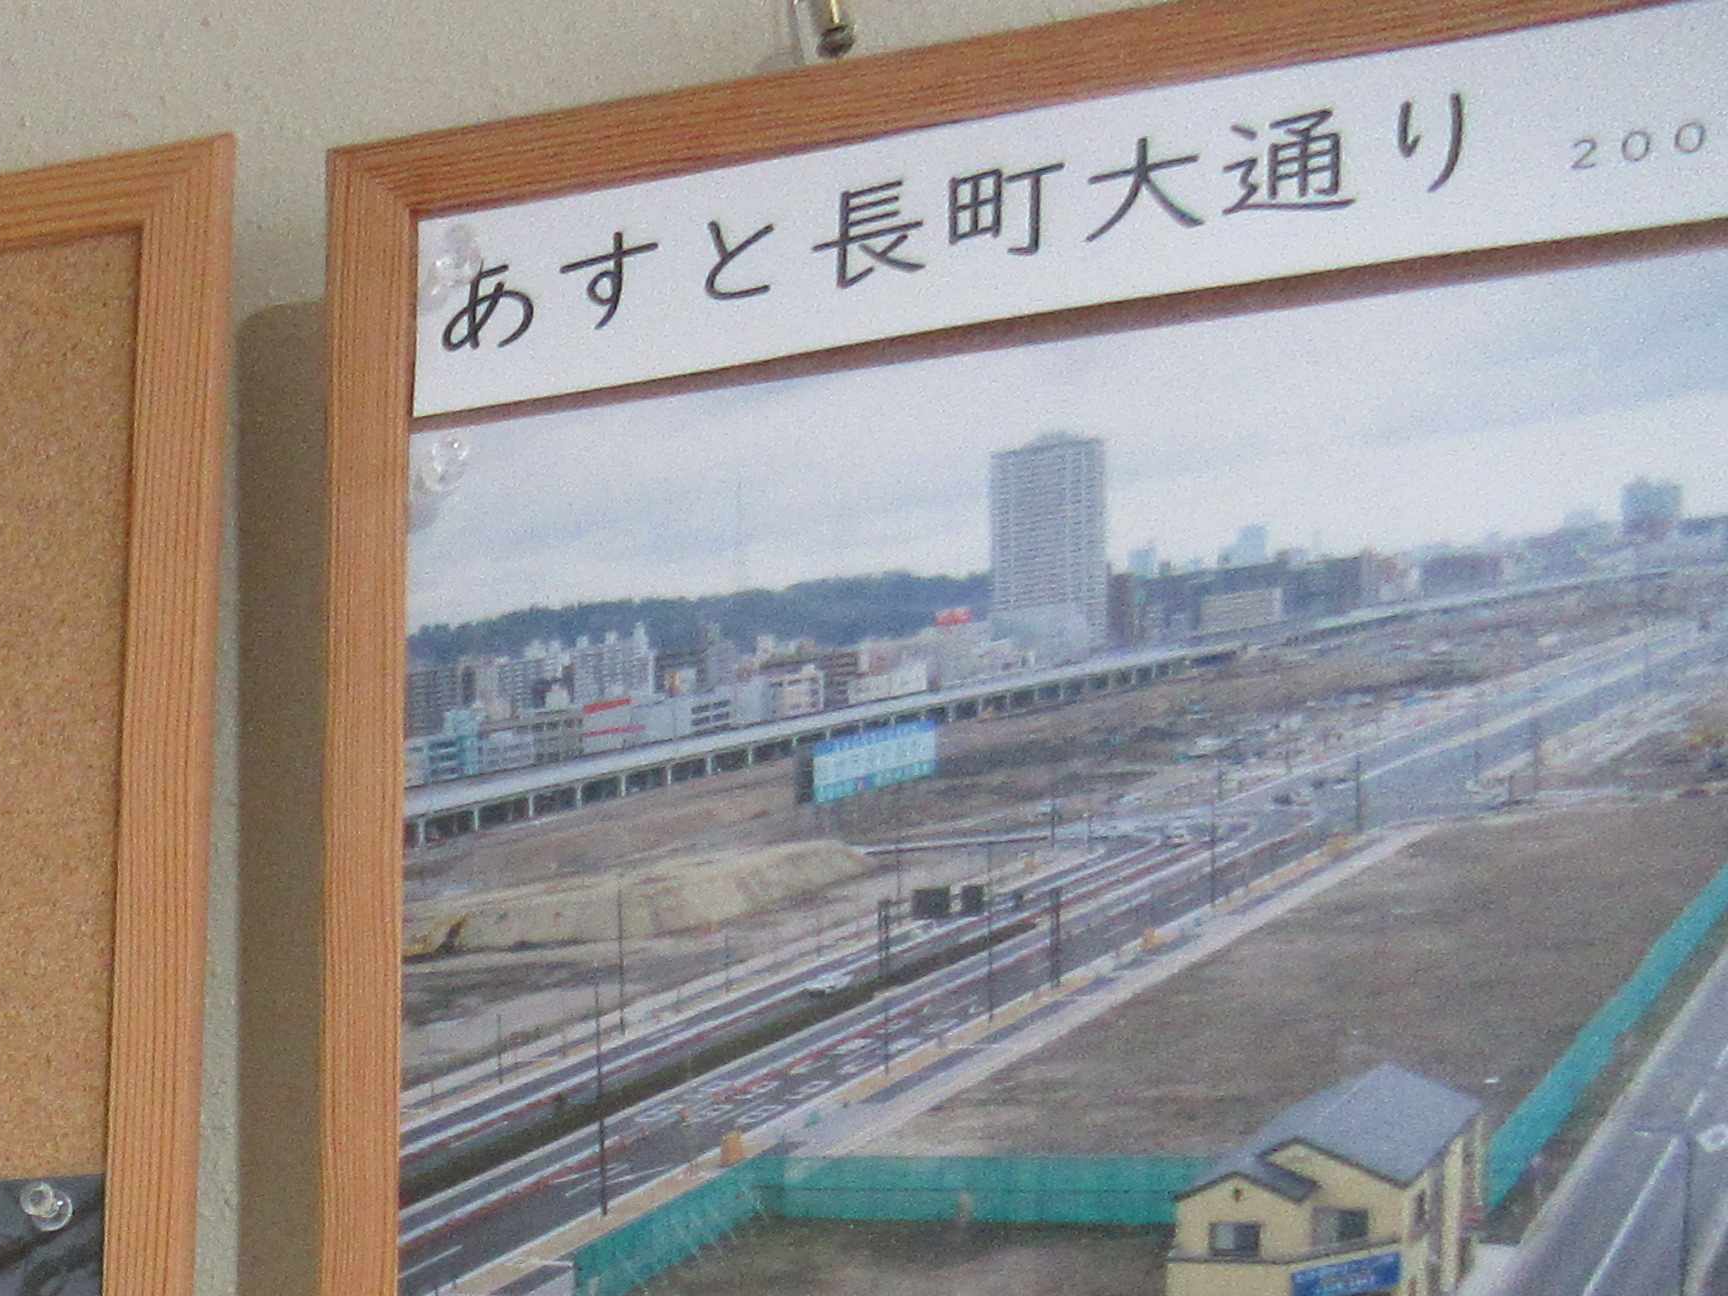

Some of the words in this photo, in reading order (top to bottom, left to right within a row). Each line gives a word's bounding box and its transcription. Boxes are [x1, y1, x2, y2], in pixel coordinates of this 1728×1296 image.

[440, 90, 1466, 353] あすと長町大通り
